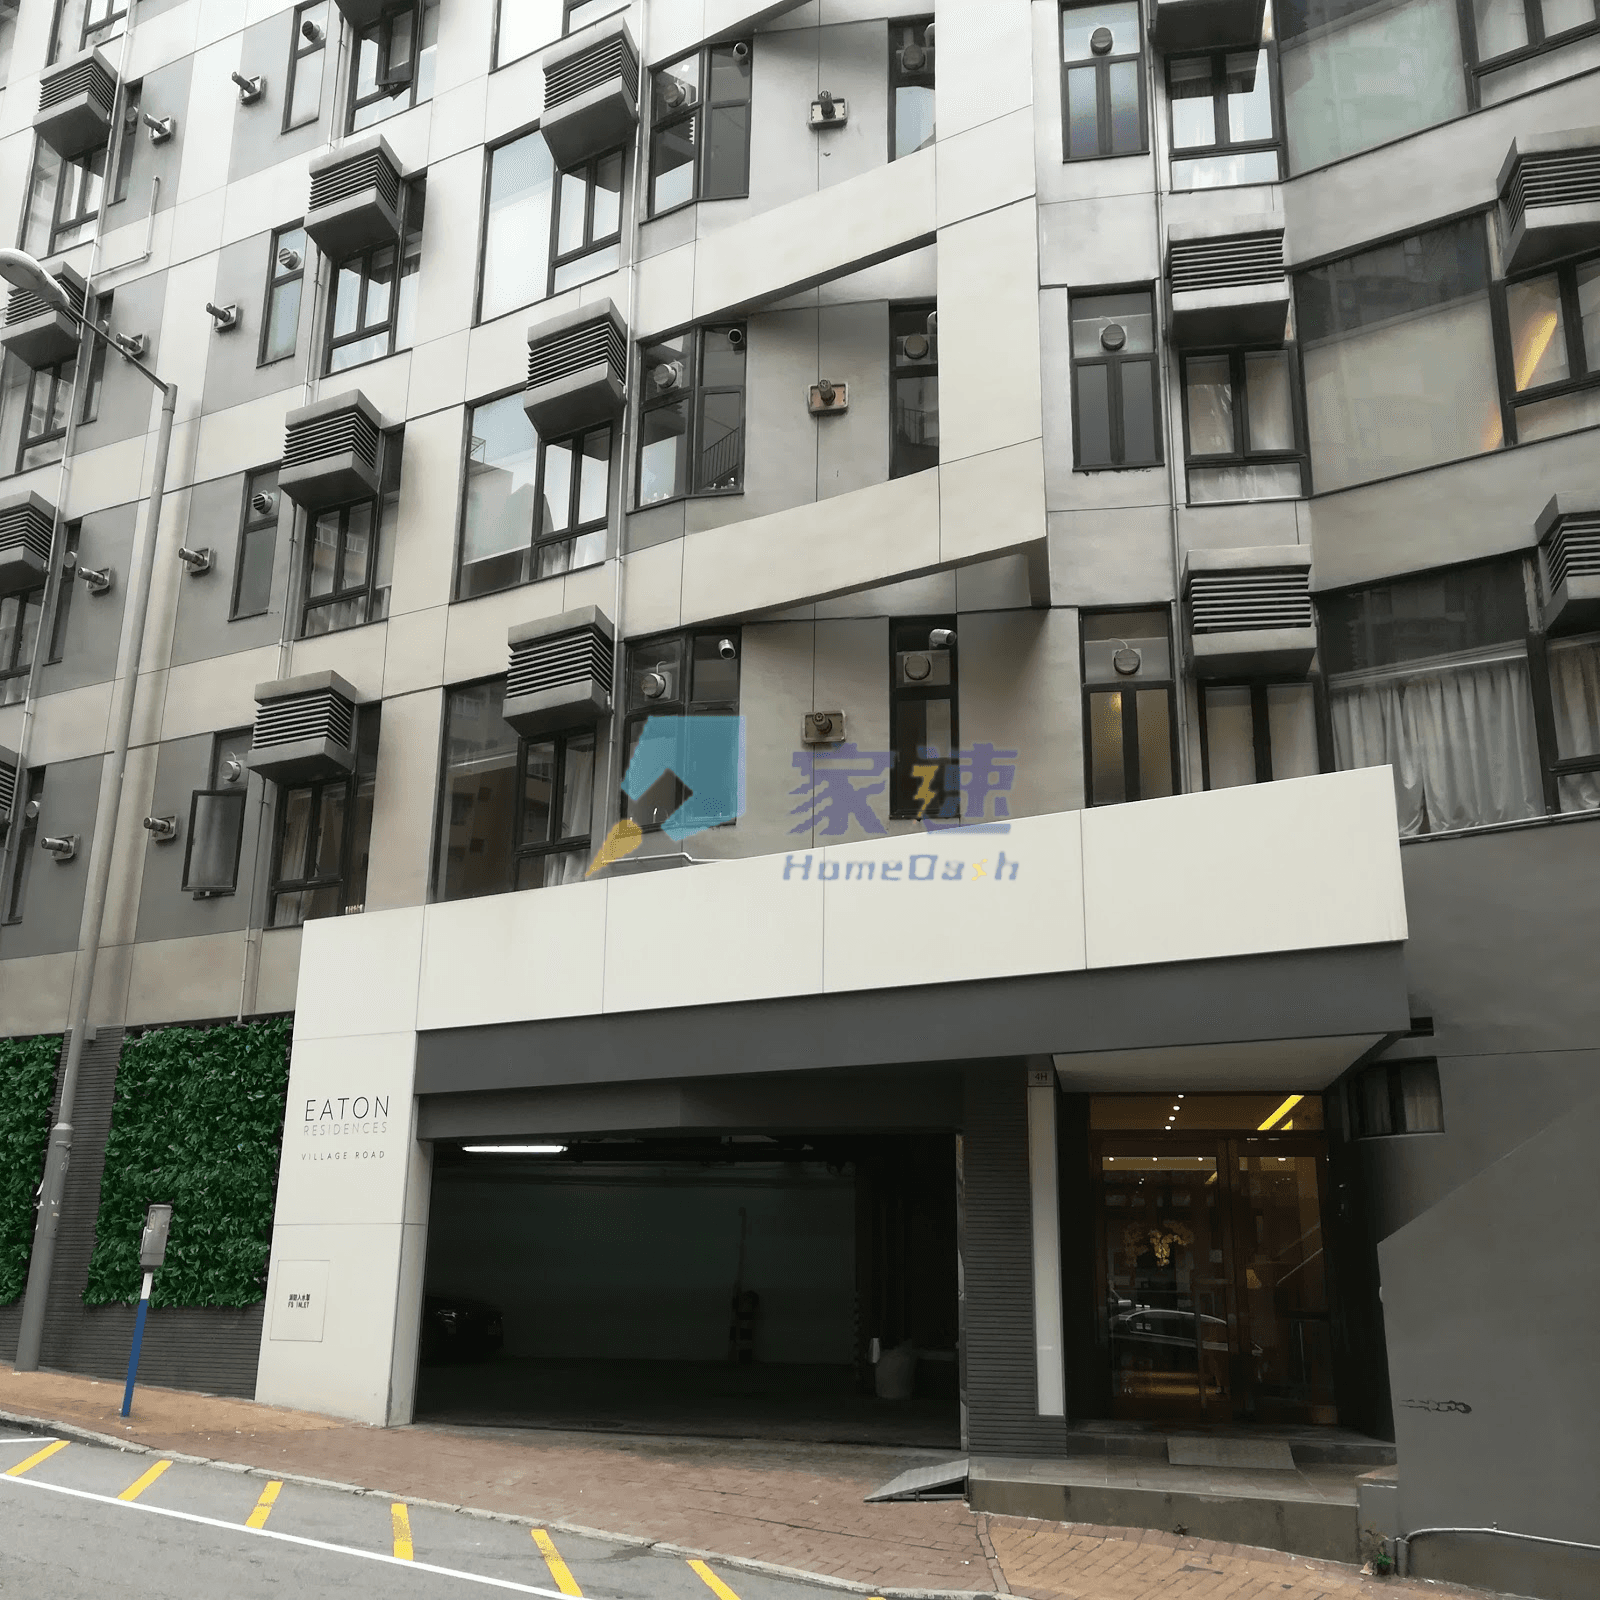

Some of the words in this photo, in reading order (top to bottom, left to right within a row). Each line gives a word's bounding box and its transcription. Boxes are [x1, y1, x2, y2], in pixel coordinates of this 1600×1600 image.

[1034, 1072, 1048, 1081] 4H
[305, 1096, 389, 1121] EATON
[303, 1122, 387, 1136] RESIDENCES
[301, 1151, 348, 1161] VILLAGE
[355, 1150, 385, 1160] ROAD
